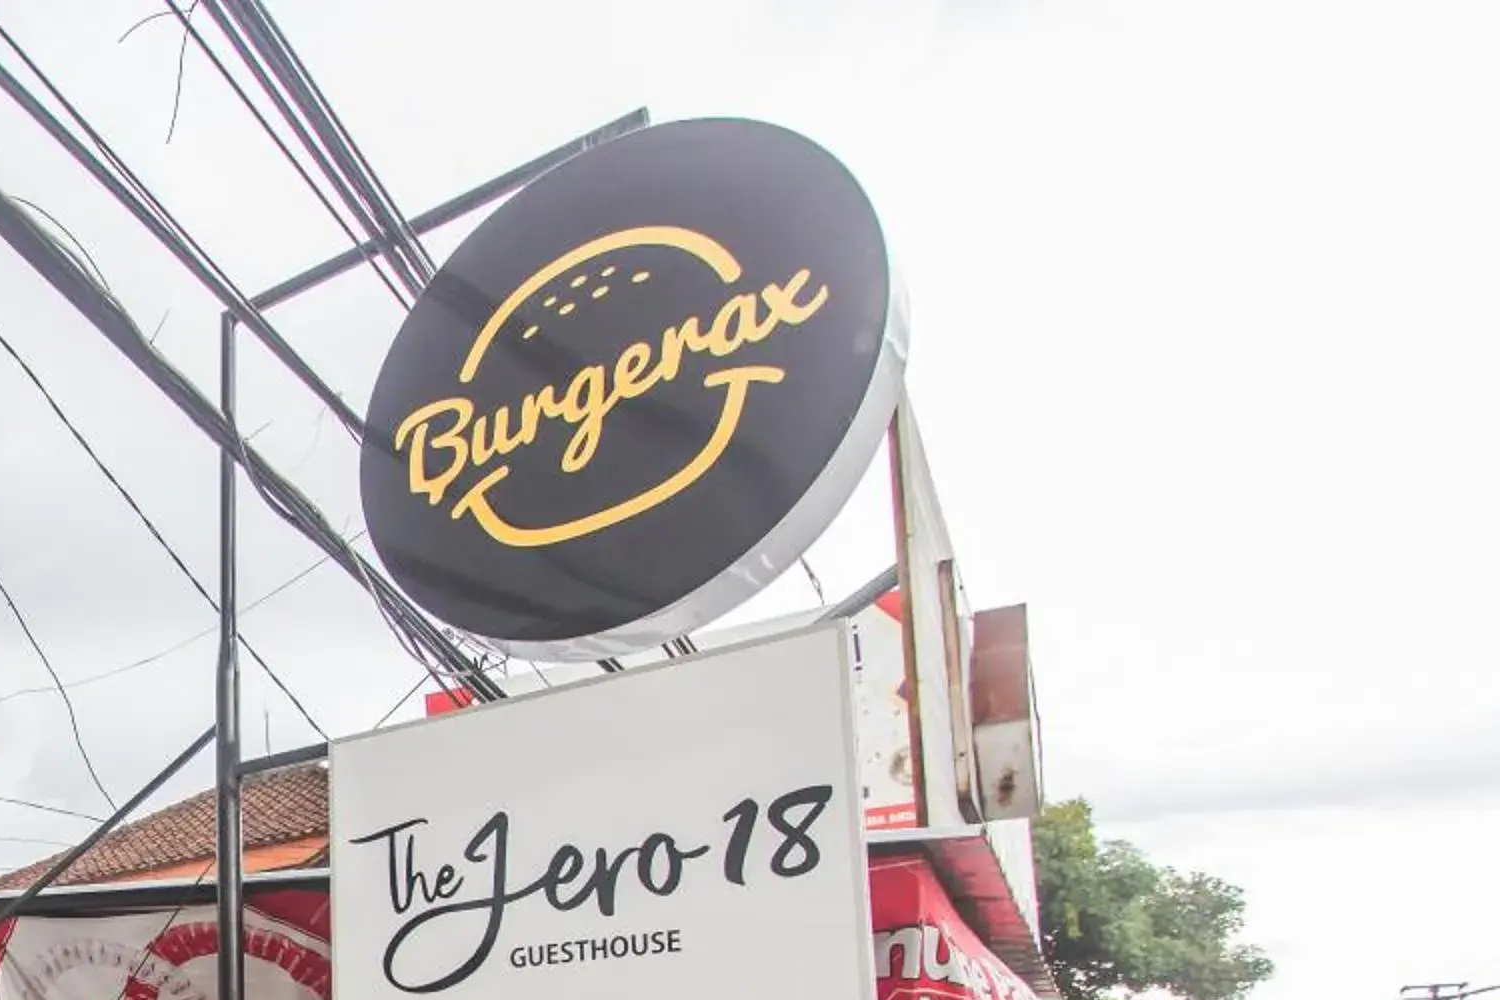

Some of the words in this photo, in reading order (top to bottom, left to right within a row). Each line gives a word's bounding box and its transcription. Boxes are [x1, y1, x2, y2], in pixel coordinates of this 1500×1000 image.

[395, 269, 829, 505] Burgerax
[350, 818, 464, 914] The
[723, 785, 833, 886] 18
[383, 812, 709, 993] Jero
[510, 929, 682, 969] GUESTHOUSE
